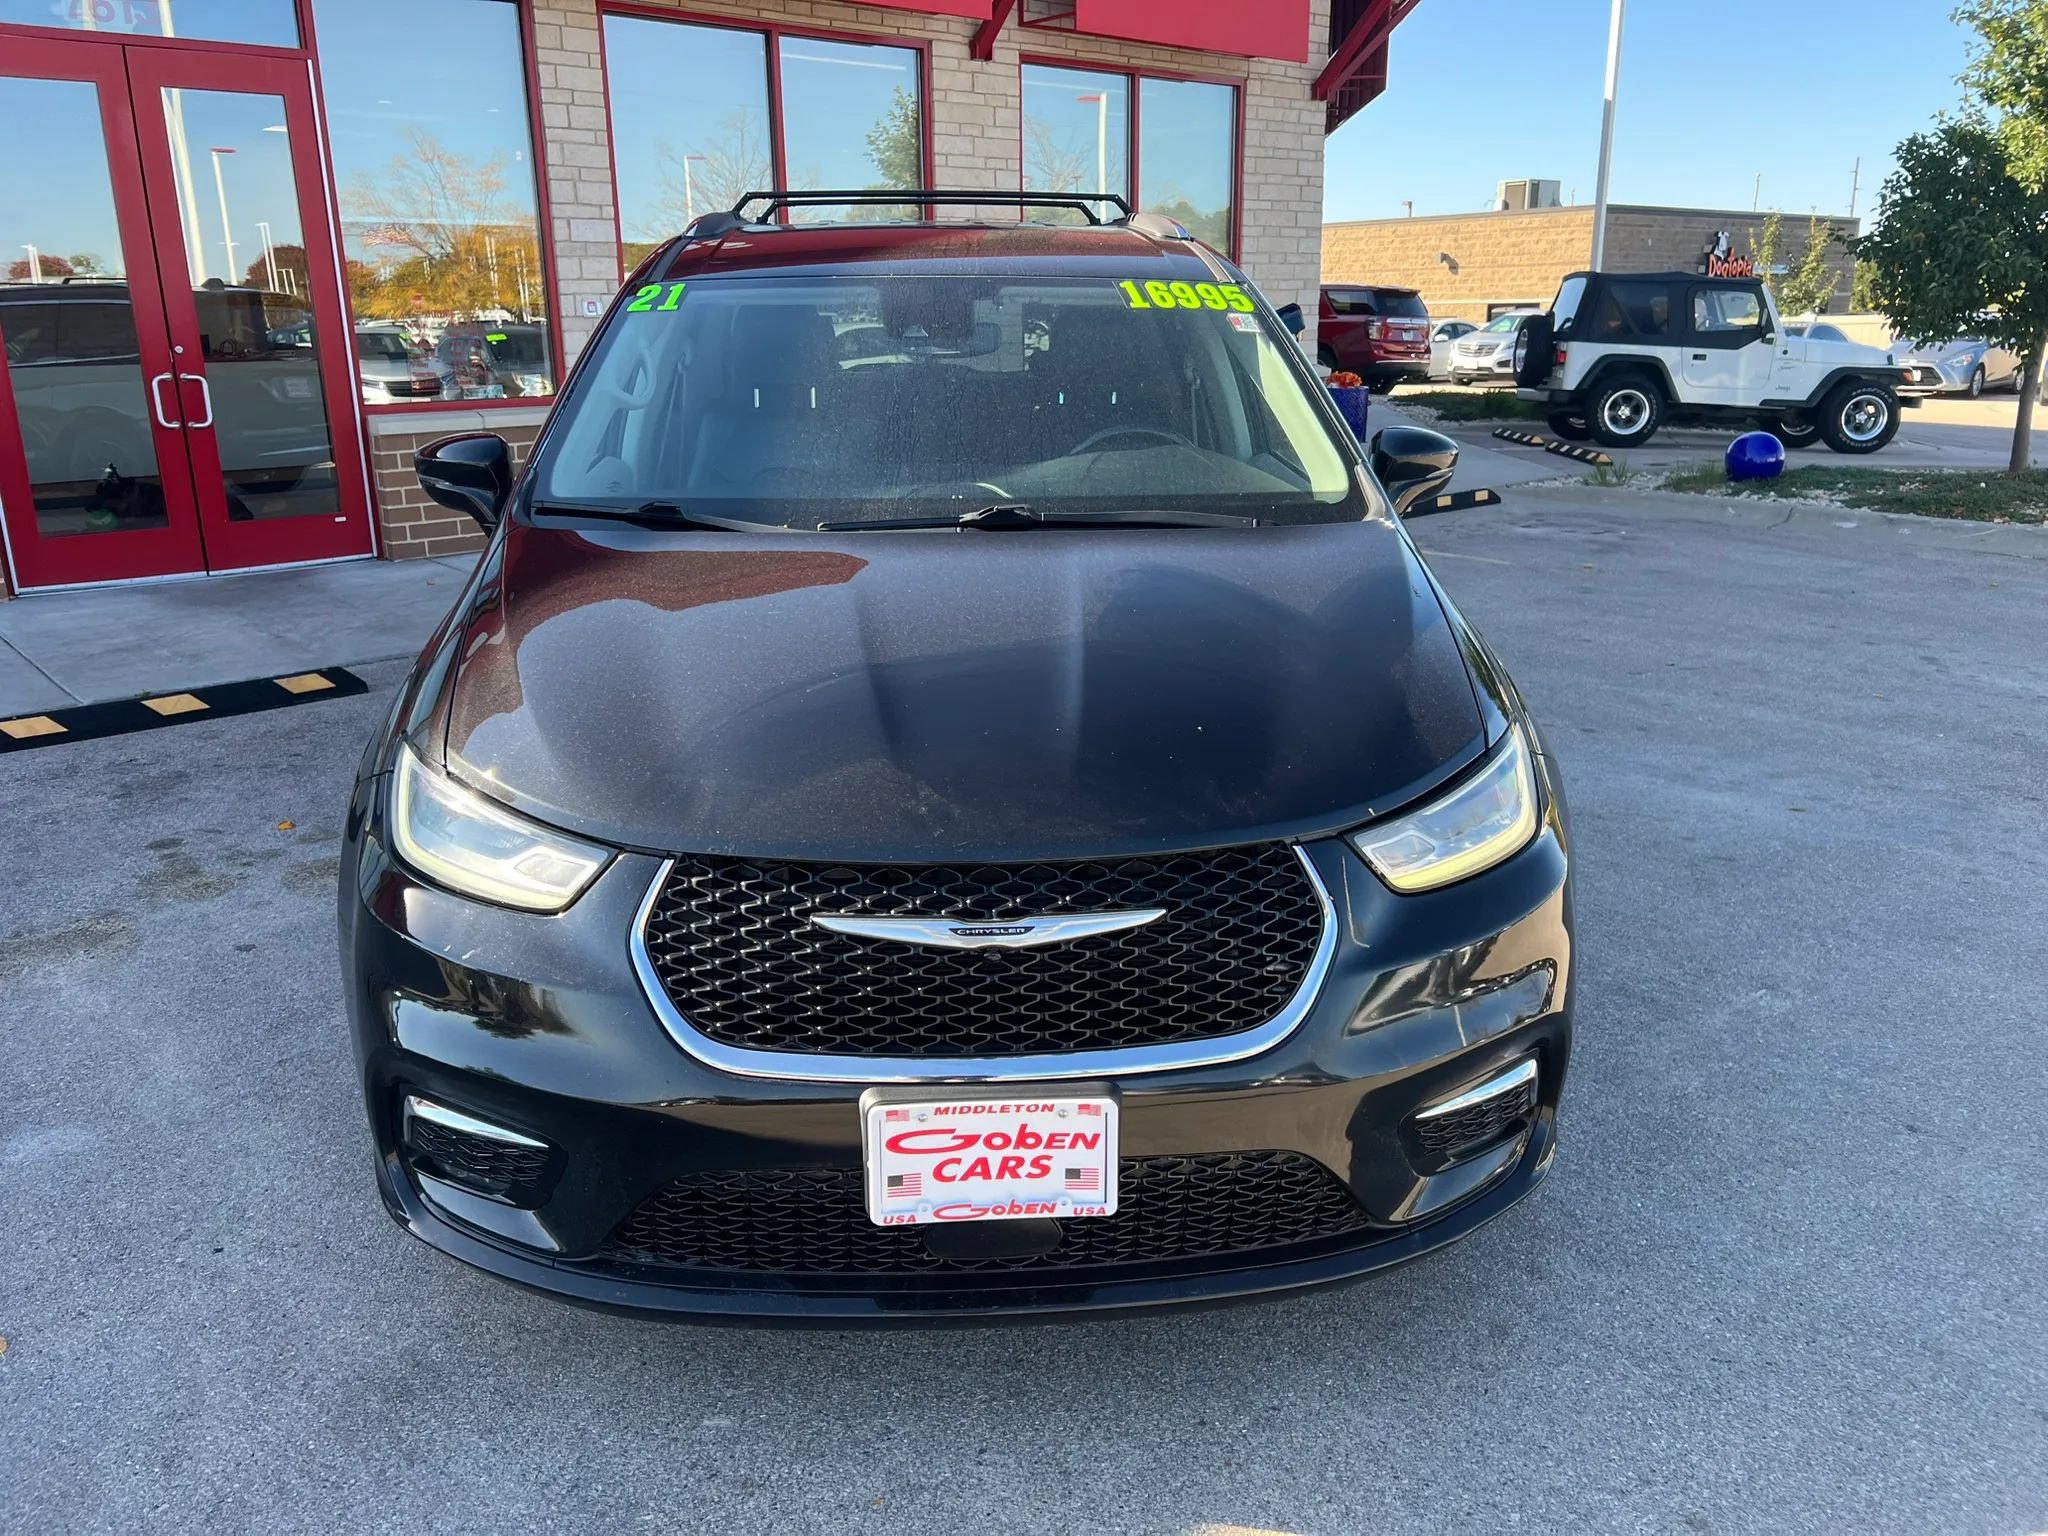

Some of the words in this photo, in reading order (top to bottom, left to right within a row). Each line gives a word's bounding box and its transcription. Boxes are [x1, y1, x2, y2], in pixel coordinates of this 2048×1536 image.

[627, 283, 686, 312] 21
[1119, 281, 1255, 313] 16995
[934, 1103, 1055, 1116] MIDDLETON
[932, 1154, 1054, 1183] CARS
[883, 1215, 917, 1225] USA
[1073, 1206, 1107, 1216] USA
